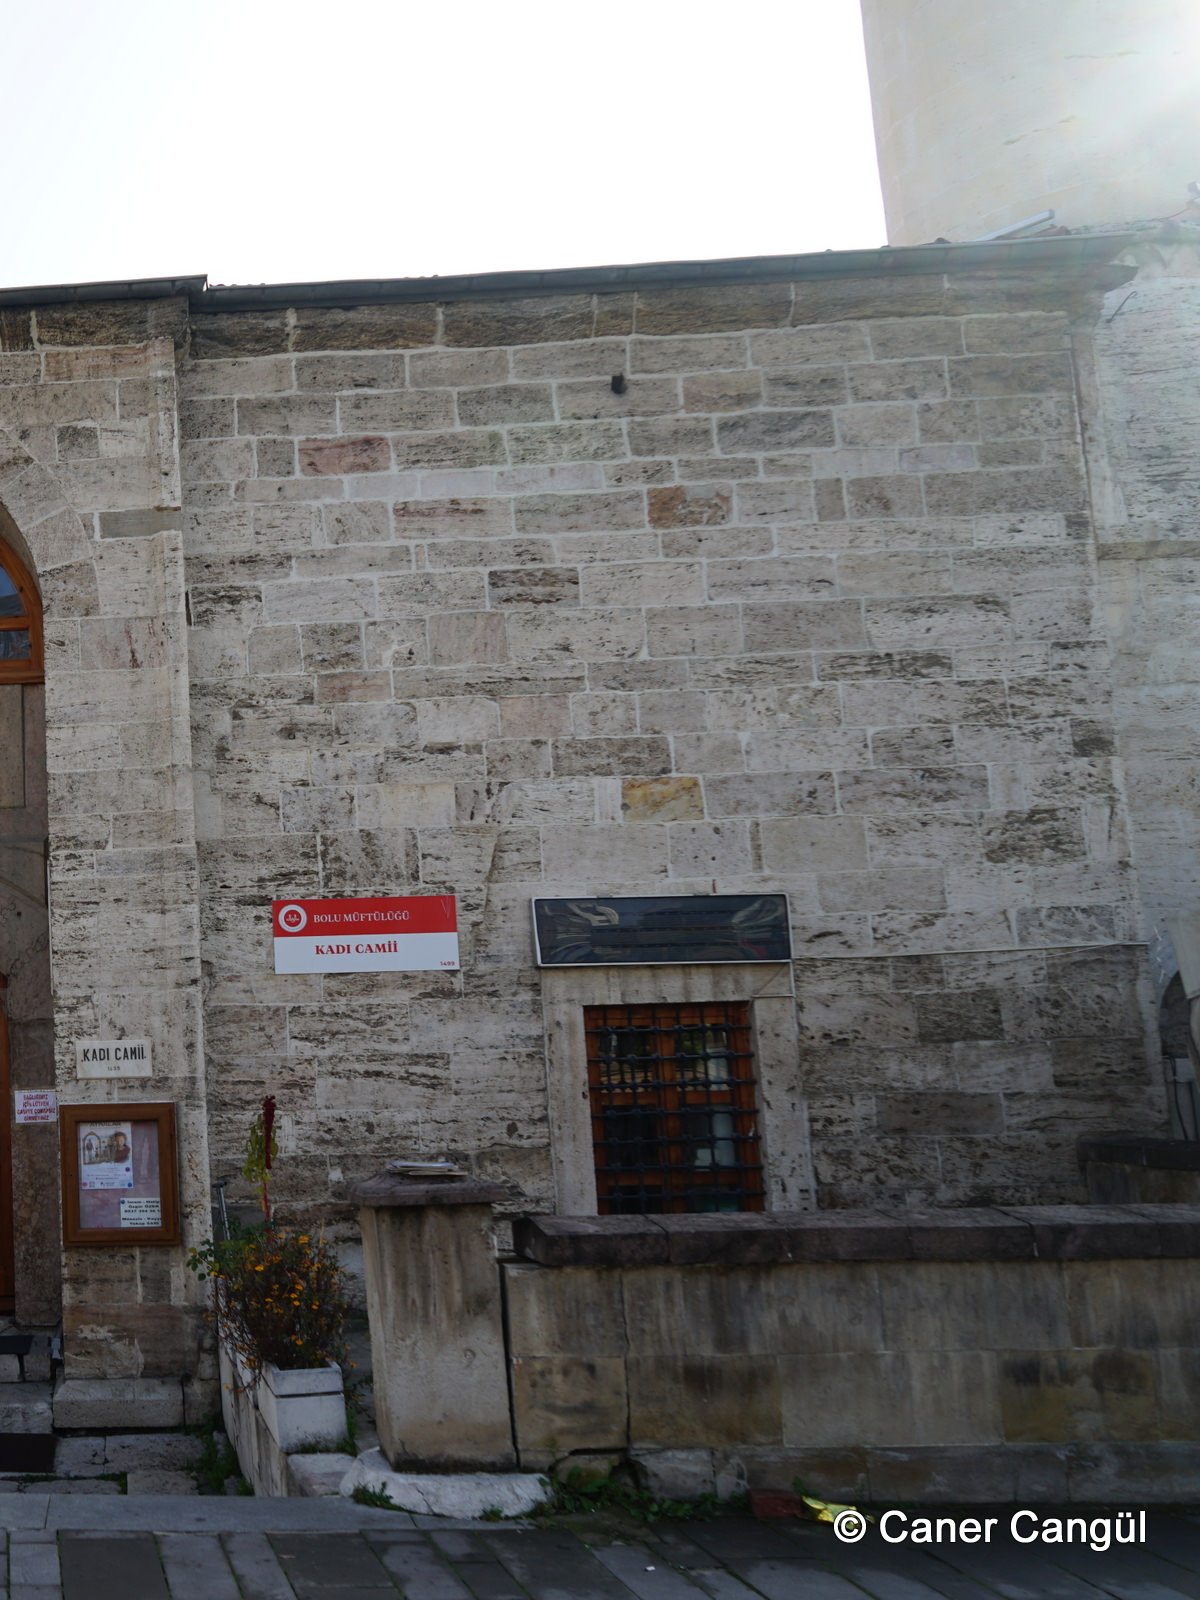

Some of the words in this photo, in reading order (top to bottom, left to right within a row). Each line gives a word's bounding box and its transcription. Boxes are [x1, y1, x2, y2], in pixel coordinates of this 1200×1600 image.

[313, 913, 342, 923] BOLU
[343, 910, 410, 922] MÜFTÜLÜĞÜ
[315, 944, 351, 955] KADI
[355, 940, 398, 954] CAMİİ
[83, 1047, 110, 1062] KADI
[114, 1044, 145, 1061] CAMİİ
